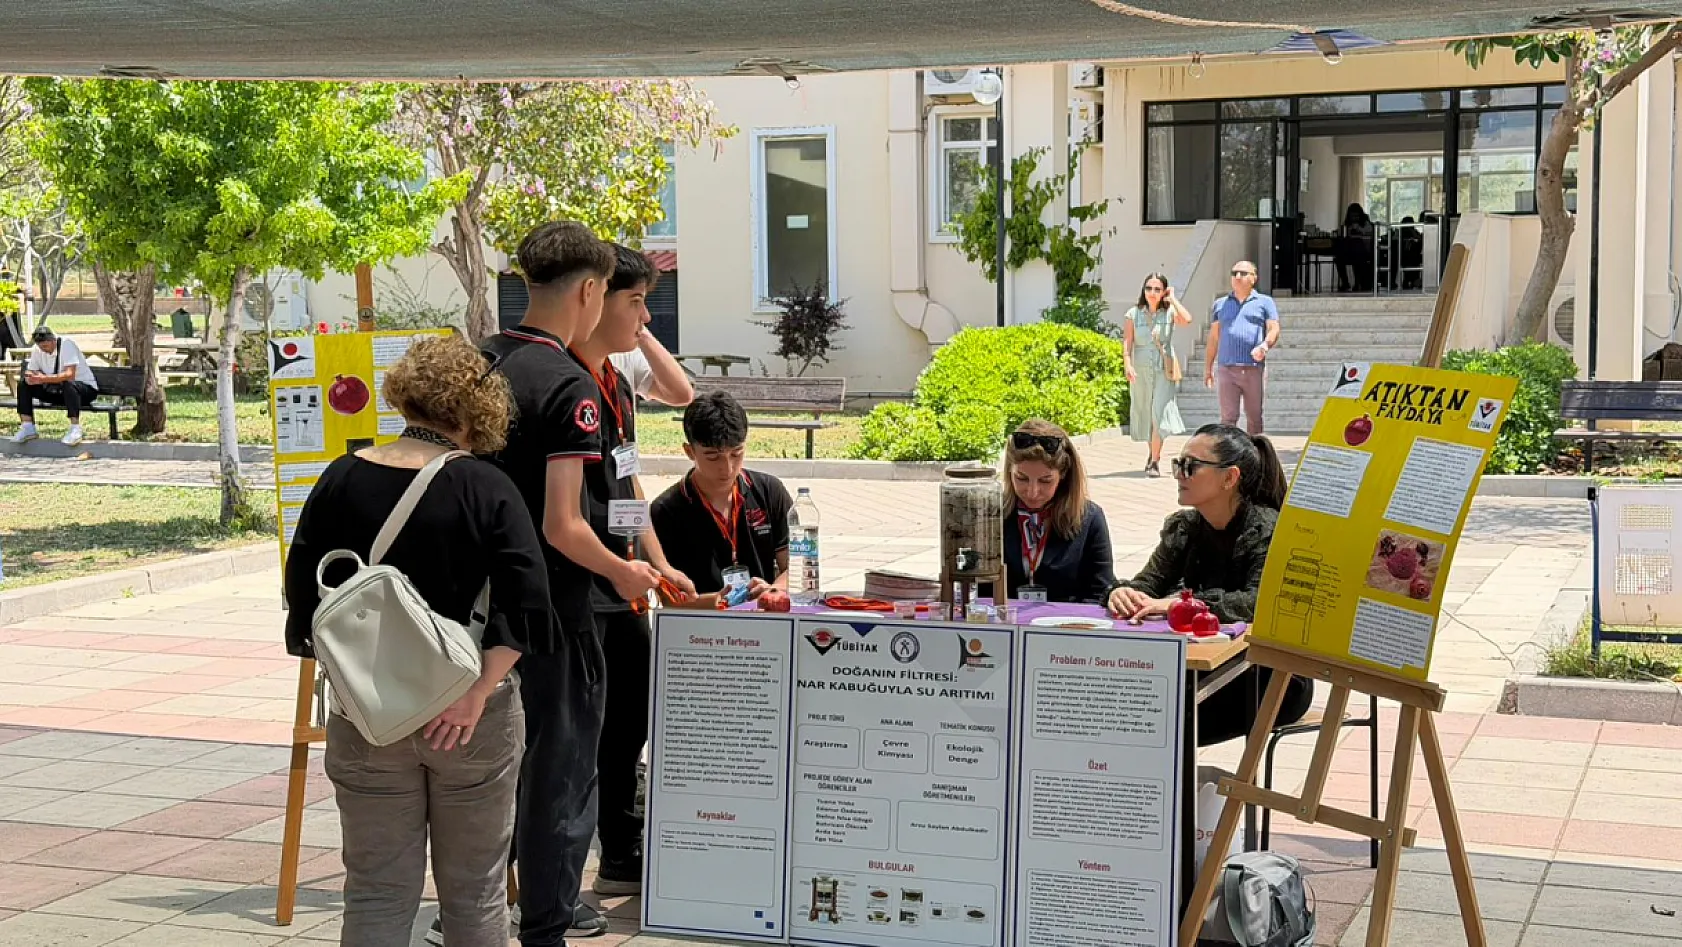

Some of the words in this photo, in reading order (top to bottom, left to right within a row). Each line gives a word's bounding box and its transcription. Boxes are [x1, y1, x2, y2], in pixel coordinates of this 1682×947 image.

[1365, 381, 1470, 410] ATIKTAN
[1376, 402, 1444, 425] FAYDAYA
[688, 634, 713, 646] Sonuç
[716, 638, 725, 646] ve
[727, 636, 761, 648] Tartışma
[837, 641, 878, 653] TÜBİTAK
[1050, 654, 1087, 666] Problem
[1094, 657, 1116, 667] Soru
[1118, 658, 1154, 670] Cümlesi
[832, 666, 896, 679] DOĞANIN
[900, 669, 958, 683] FİLTRESİ:
[797, 680, 825, 690] NAR
[829, 681, 913, 696] KABUĞUYLA
[917, 687, 935, 697] SU
[939, 689, 995, 701] ARITIMI
[803, 739, 849, 749] Araştırma
[882, 739, 910, 748] Çevre
[946, 743, 984, 753] Ekolojik
[877, 750, 914, 759] Kimyası
[948, 755, 979, 764] Denge
[1088, 758, 1108, 771] Özet
[697, 809, 737, 821] Kaynaklar
[868, 860, 915, 873] BULGULAR
[1078, 859, 1112, 872] Yöntem
